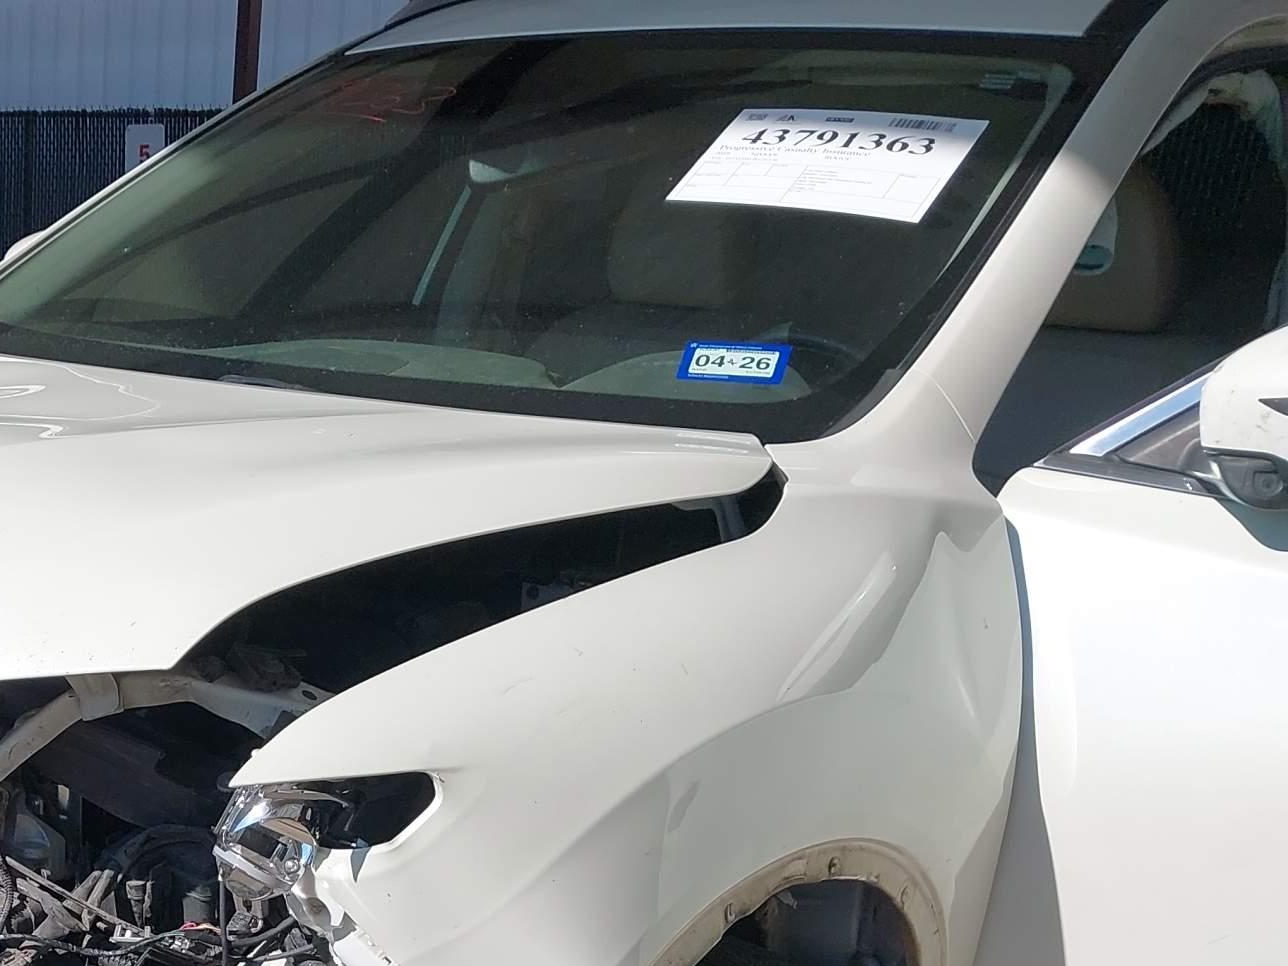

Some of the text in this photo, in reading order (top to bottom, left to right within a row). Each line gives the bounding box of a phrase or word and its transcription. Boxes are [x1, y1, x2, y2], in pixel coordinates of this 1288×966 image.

[741, 126, 936, 155] 43791363
[139, 143, 150, 160] 5
[694, 353, 772, 370] 04 26
